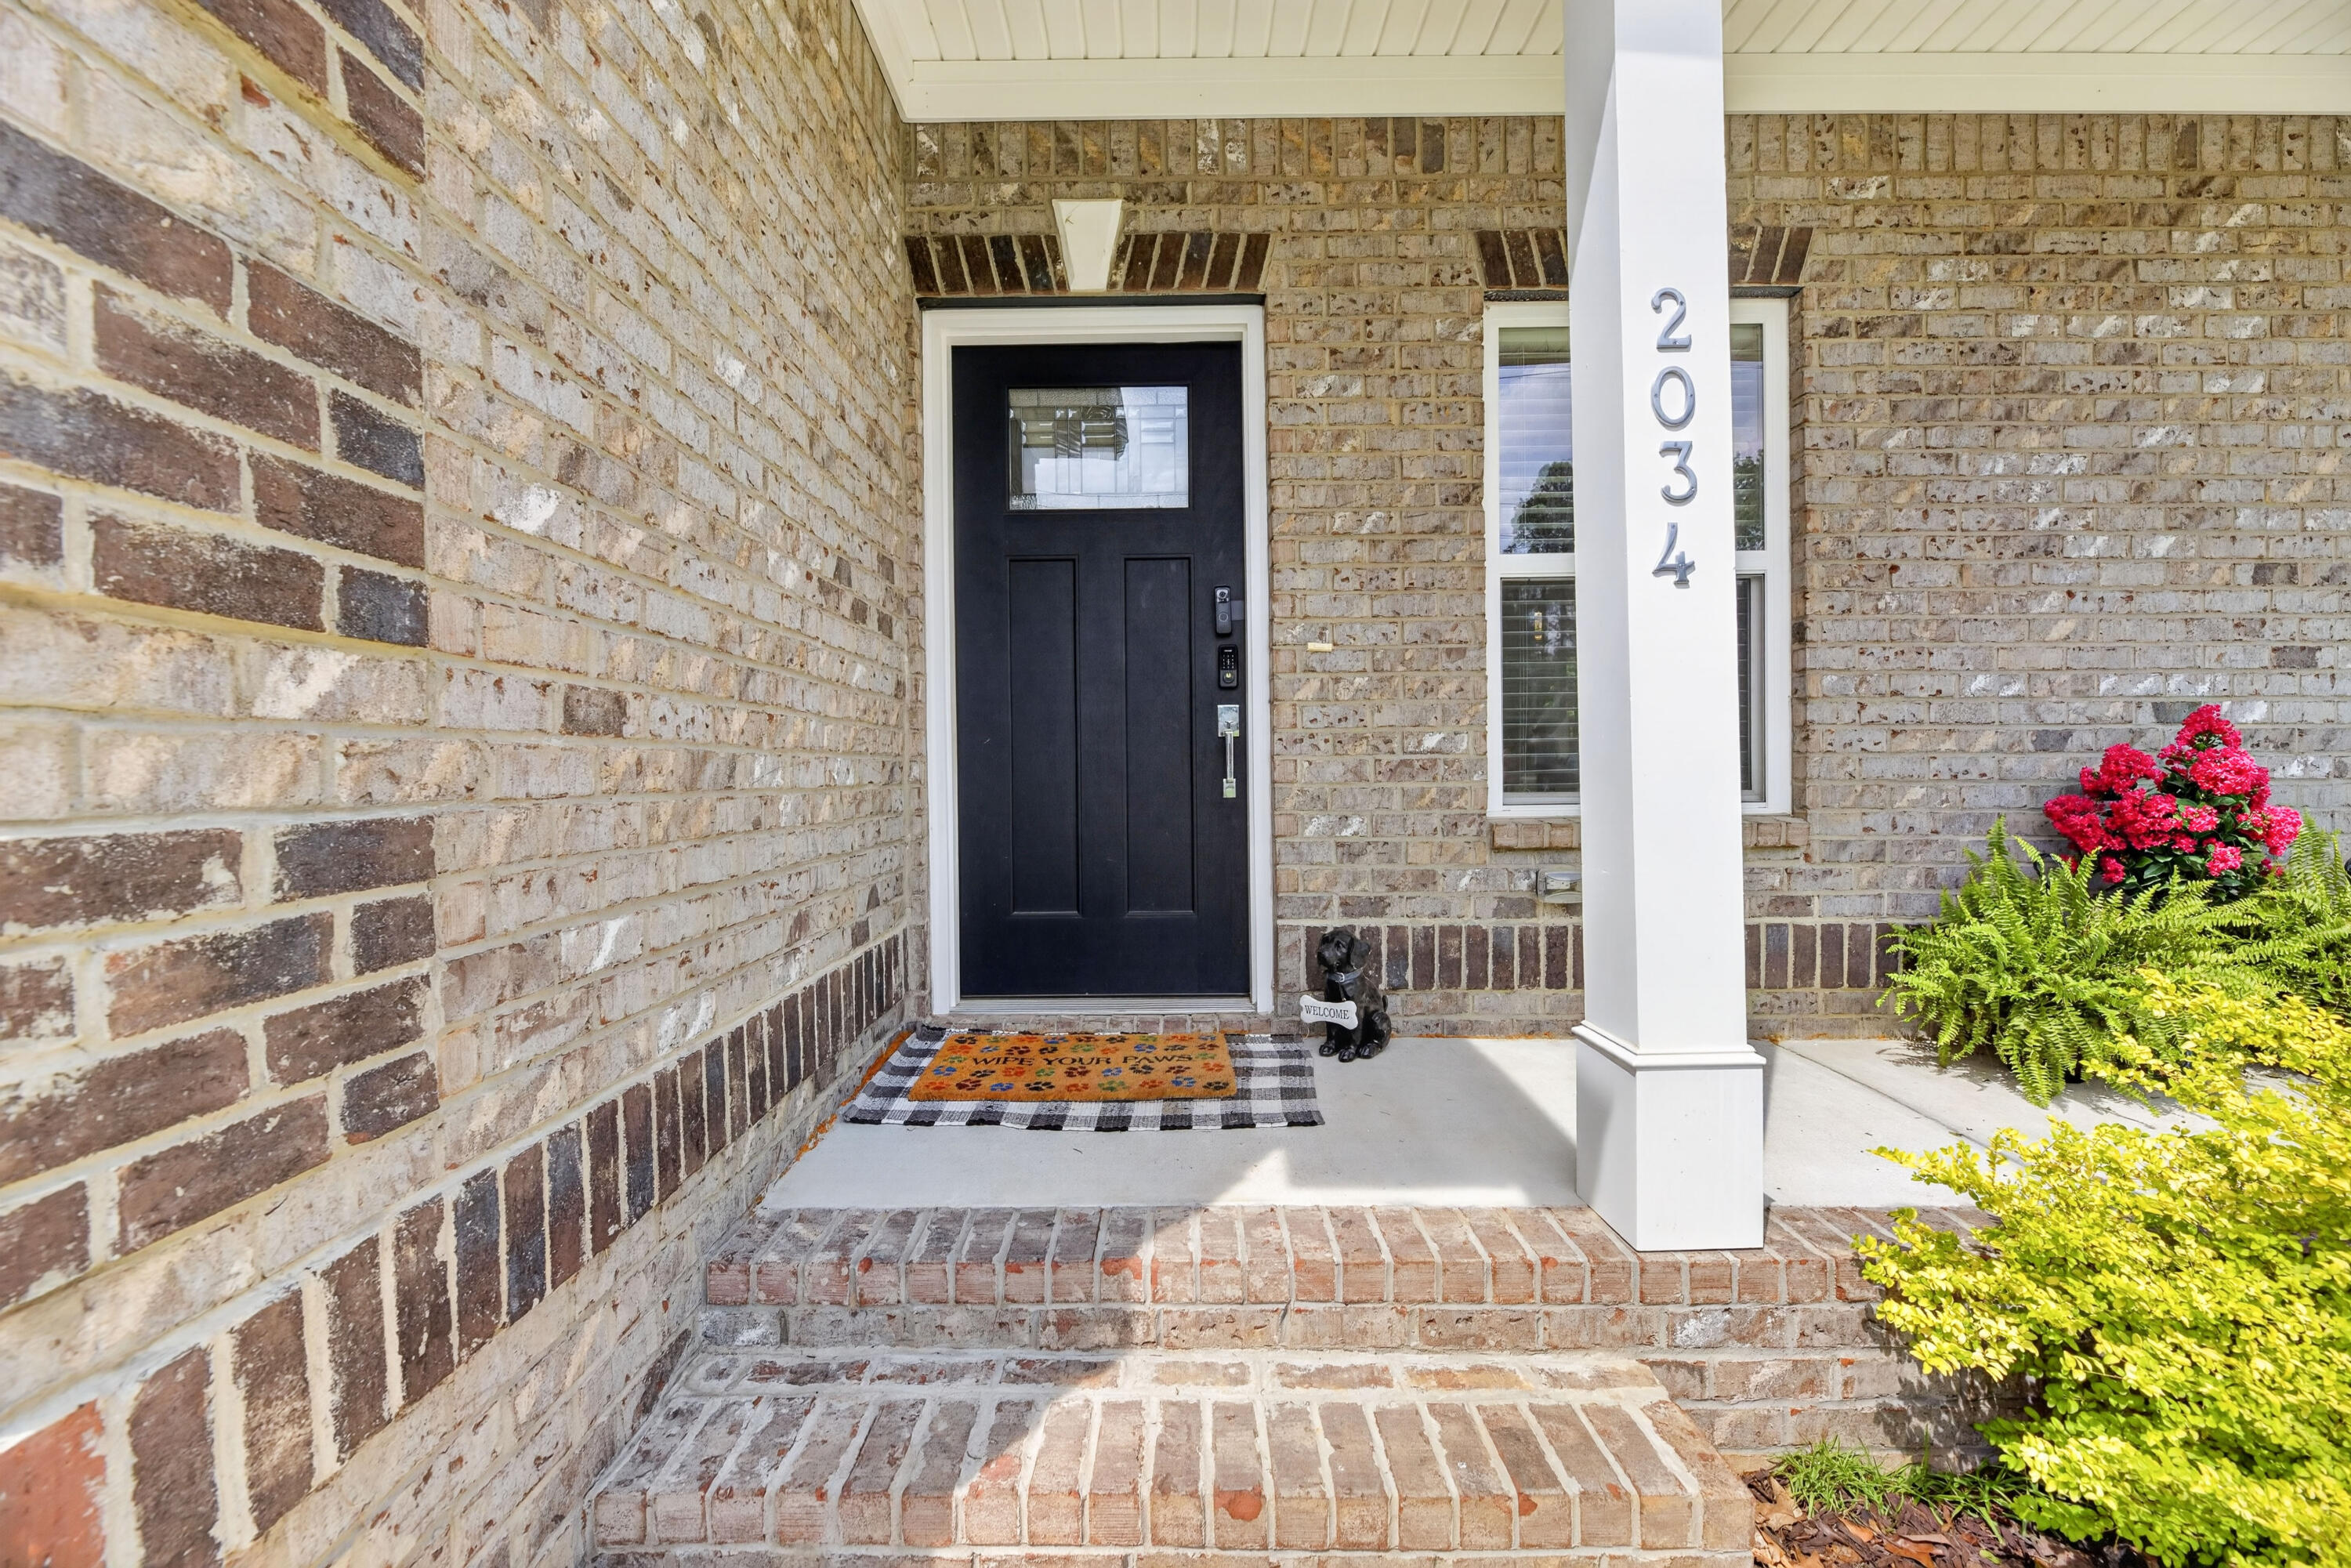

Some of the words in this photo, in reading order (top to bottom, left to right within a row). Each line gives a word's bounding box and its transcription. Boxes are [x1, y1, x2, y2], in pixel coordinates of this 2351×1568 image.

[1650, 287, 1697, 588] 2034
[1304, 1005, 1350, 1019] WELCOME
[972, 1056, 1035, 1066] WIPE
[1043, 1056, 1111, 1066] YOUR
[1122, 1055, 1193, 1064] PAWS
